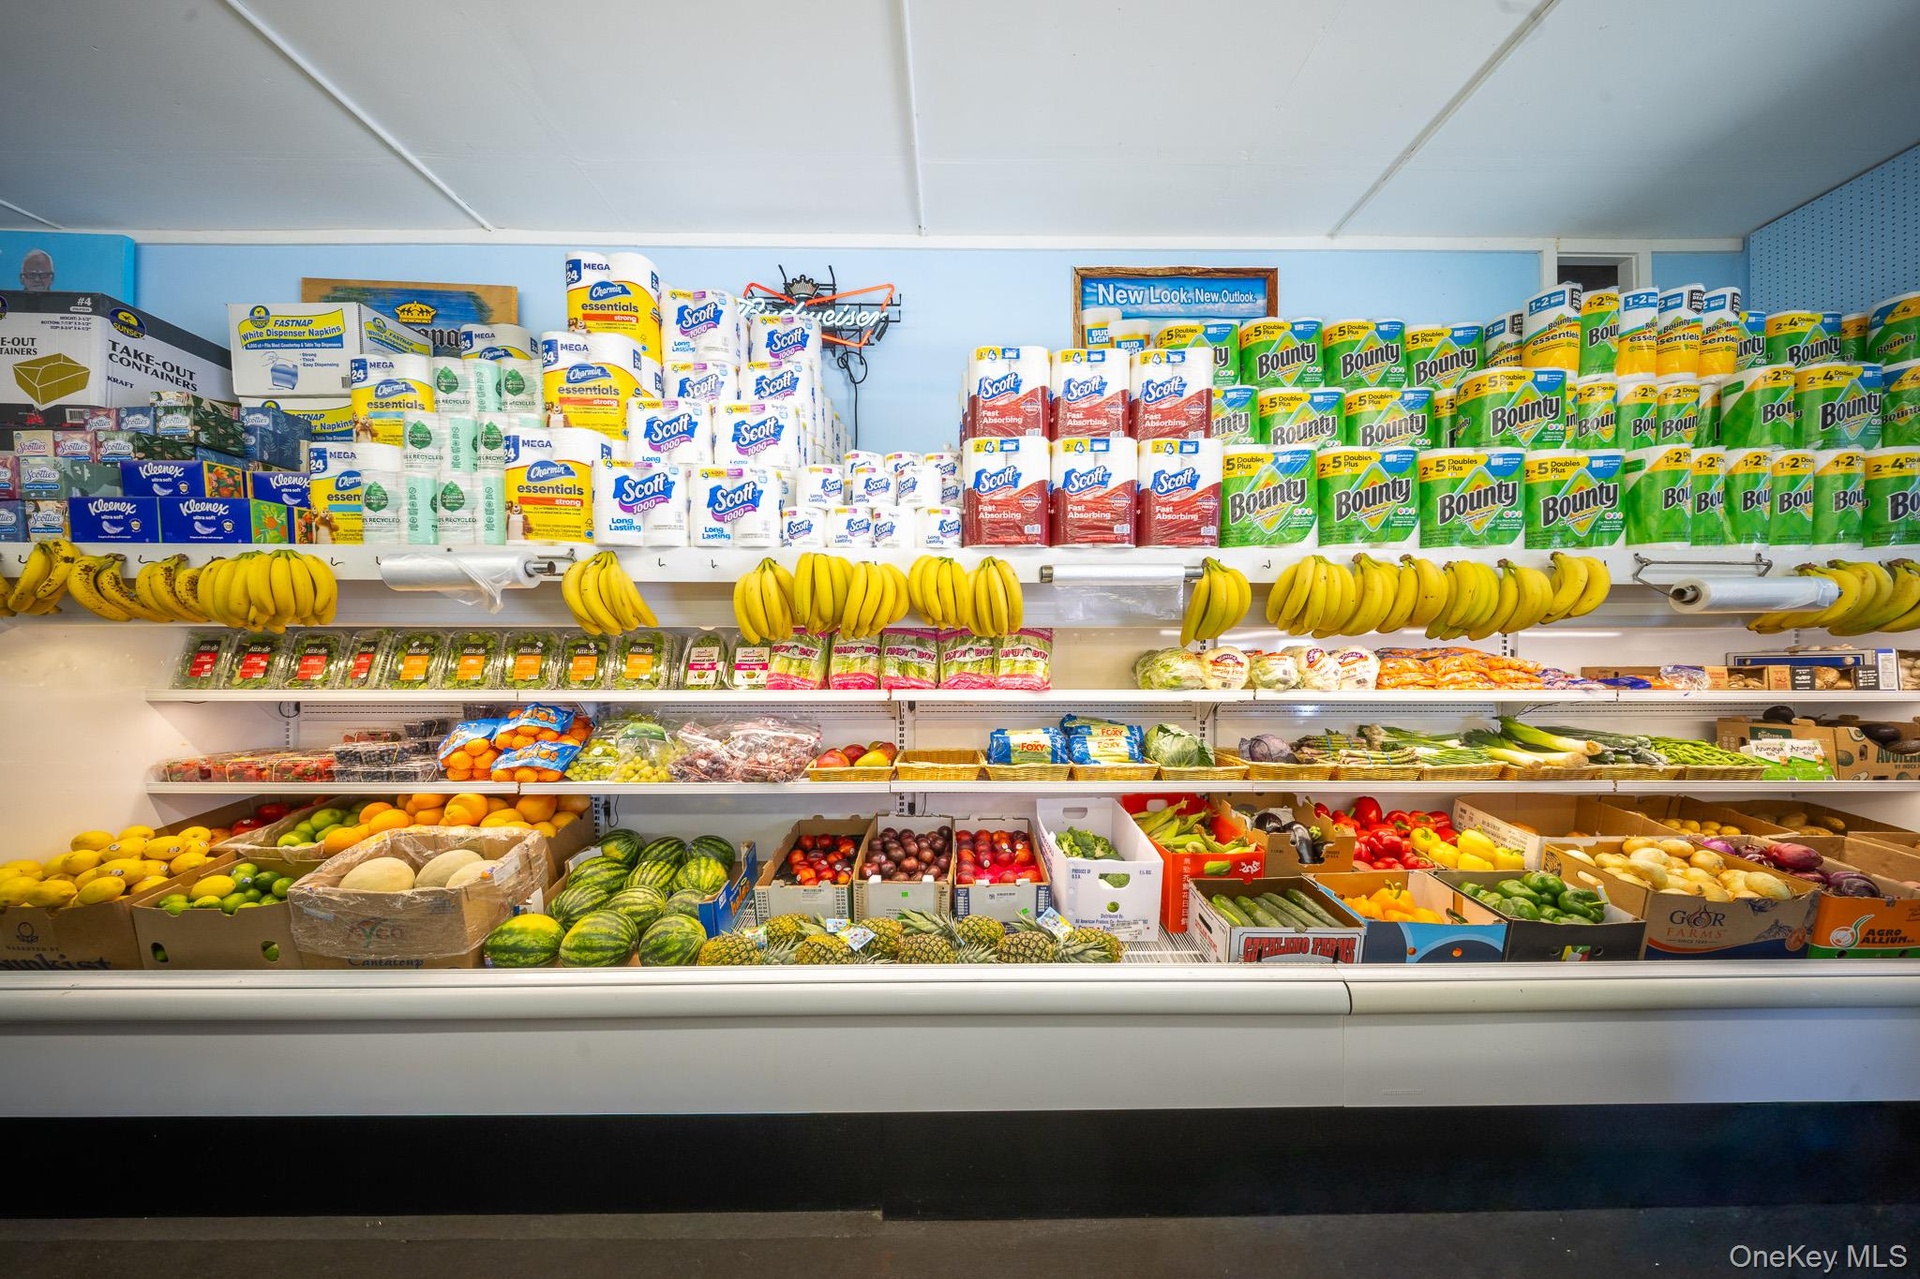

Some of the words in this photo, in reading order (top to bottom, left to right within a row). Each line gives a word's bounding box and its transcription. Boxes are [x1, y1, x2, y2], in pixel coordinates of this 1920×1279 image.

[583, 263, 611, 271] MEGA
[592, 284, 622, 297] Charmin
[1097, 283, 1144, 304] New
[1149, 286, 1192, 304] Look.
[1195, 288, 1219, 303] New
[1221, 288, 1257, 304] Outlook.
[581, 302, 639, 313] essentials
[684, 302, 717, 328] Scott
[113, 322, 144, 338] SUNSET
[274, 319, 313, 327] FASTNAP
[1547, 317, 1572, 331] Bounty
[1663, 318, 1691, 334] Bounty
[1705, 320, 1733, 335] Bounty
[242, 330, 264, 342] White
[266, 328, 305, 338] Dispenser
[308, 325, 341, 337] Napkins
[772, 327, 805, 351] Scott
[1092, 330, 1109, 338] BUD
[560, 344, 589, 352] MEGA
[674, 342, 691, 351] Long
[1121, 341, 1140, 350] BUD
[1786, 334, 1842, 367] Bounty
[1876, 332, 1917, 357] Bounty
[108, 339, 196, 381] TAKE-OUT
[370, 361, 394, 369] MEGA
[1257, 342, 1317, 380] Bounty
[1341, 342, 1401, 380] Bounty
[1413, 346, 1477, 387] Bounty
[108, 353, 198, 392] CONTAINERS
[569, 368, 604, 380] Charmin
[107, 376, 134, 389] KRAFT
[558, 385, 620, 396] essentials
[761, 371, 794, 396] Scott
[984, 373, 1016, 396] Scott
[1069, 376, 1102, 398] Scott
[1144, 376, 1181, 399] Scott
[368, 399, 426, 411] essentials
[1819, 392, 1882, 432] Bounty
[983, 416, 1023, 425] Absorbing
[1067, 418, 1108, 426] Absorbing
[1490, 395, 1561, 438] Bounty
[652, 413, 692, 441] Scott
[739, 417, 777, 444] Scott
[1272, 413, 1338, 446] Bounty
[1360, 413, 1427, 446] Bounty
[521, 440, 552, 448] MEGA
[329, 452, 357, 460] MEGA
[642, 456, 661, 464] Long
[139, 462, 184, 479] Kleenex
[531, 467, 567, 479] Charmin
[980, 467, 1016, 491] Scott
[1070, 467, 1105, 491] Scott
[1158, 468, 1193, 492] Scott
[517, 485, 584, 496] essentials
[622, 473, 667, 502] Scott
[715, 481, 756, 511] Scott
[1229, 477, 1307, 525] Bounty
[1335, 477, 1411, 523] Bounty
[1438, 480, 1518, 526] Bounty
[87, 498, 137, 516] Kleenex
[179, 498, 229, 516] Kleenex
[1541, 481, 1619, 528] Bounty
[611, 517, 634, 527] Long
[1156, 512, 1198, 521] Absorbing
[609, 524, 642, 532] Lasting
[702, 532, 731, 540] Lasting
[704, 527, 725, 536] Long
[1101, 727, 1123, 736] FOXY
[1021, 741, 1045, 751] FOXY
[1667, 927, 1722, 939] FARMS
[1861, 935, 1908, 944] ALLIUM
